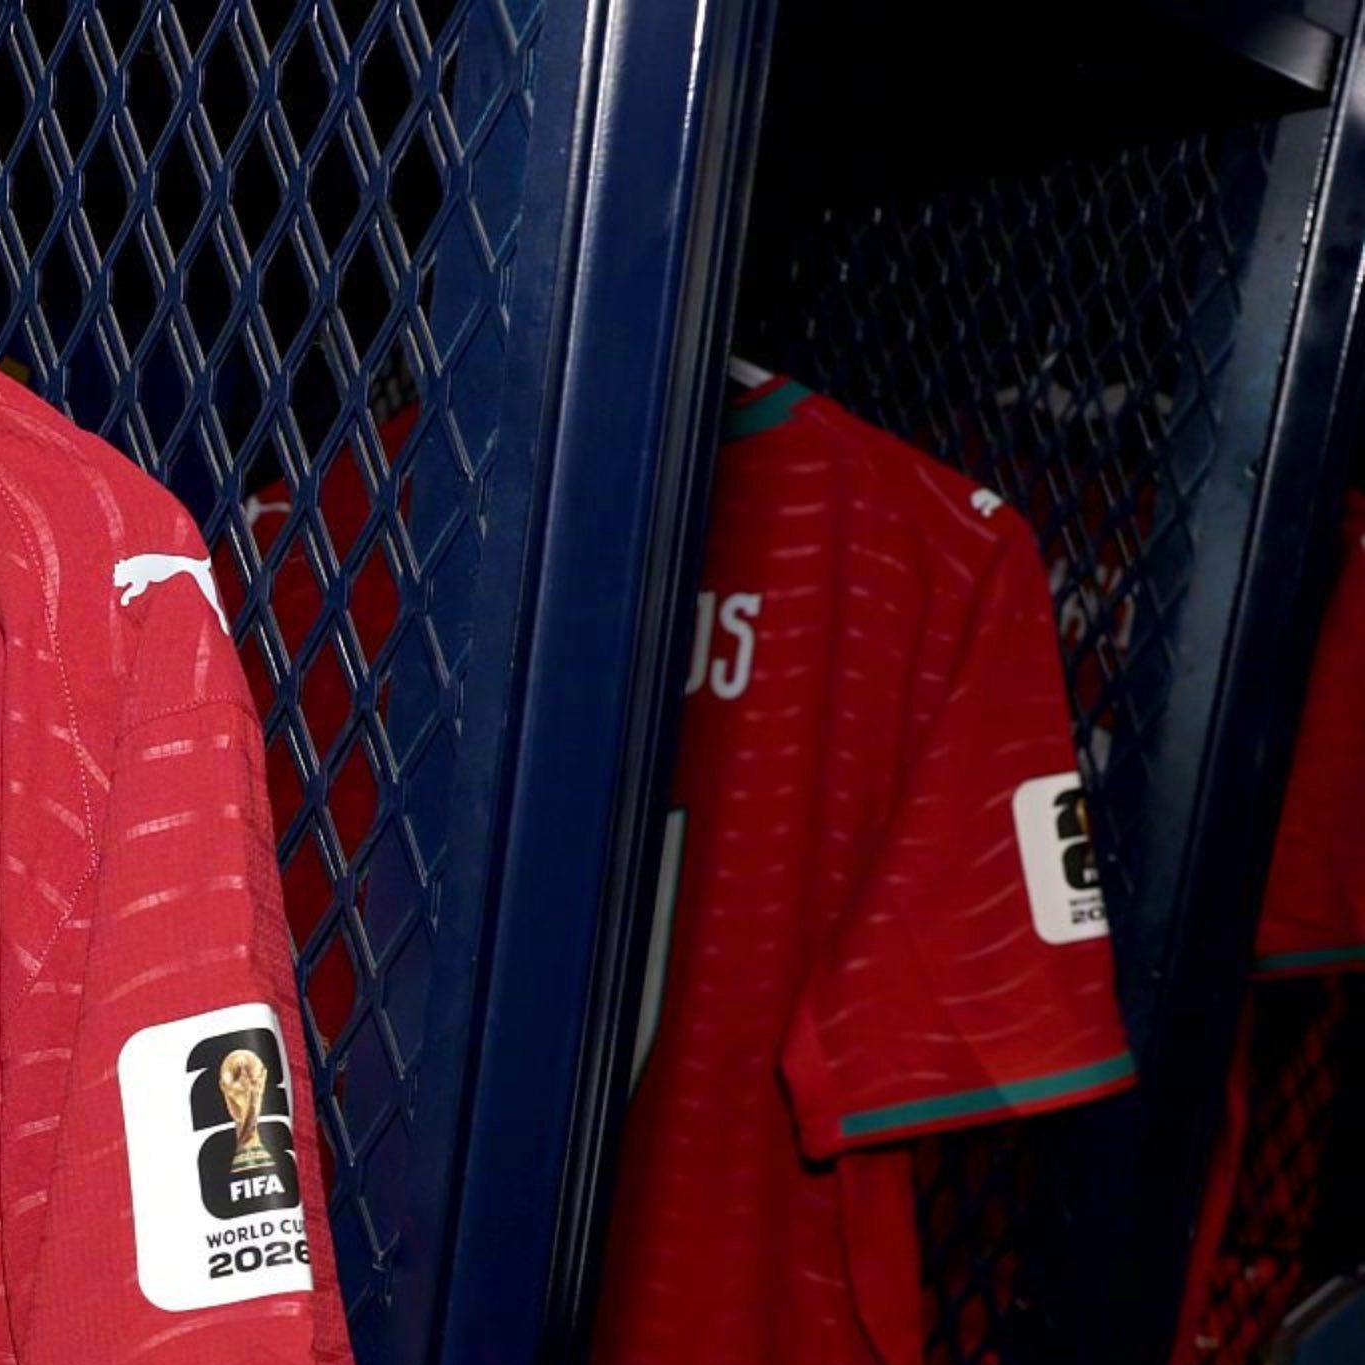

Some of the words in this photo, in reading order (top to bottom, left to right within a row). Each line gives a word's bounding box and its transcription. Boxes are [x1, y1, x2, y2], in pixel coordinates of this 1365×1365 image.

[230, 1174, 285, 1202] FIFA
[206, 1222, 274, 1248] WORLD
[280, 1219, 305, 1234] CU
[208, 1239, 311, 1278] 2026
